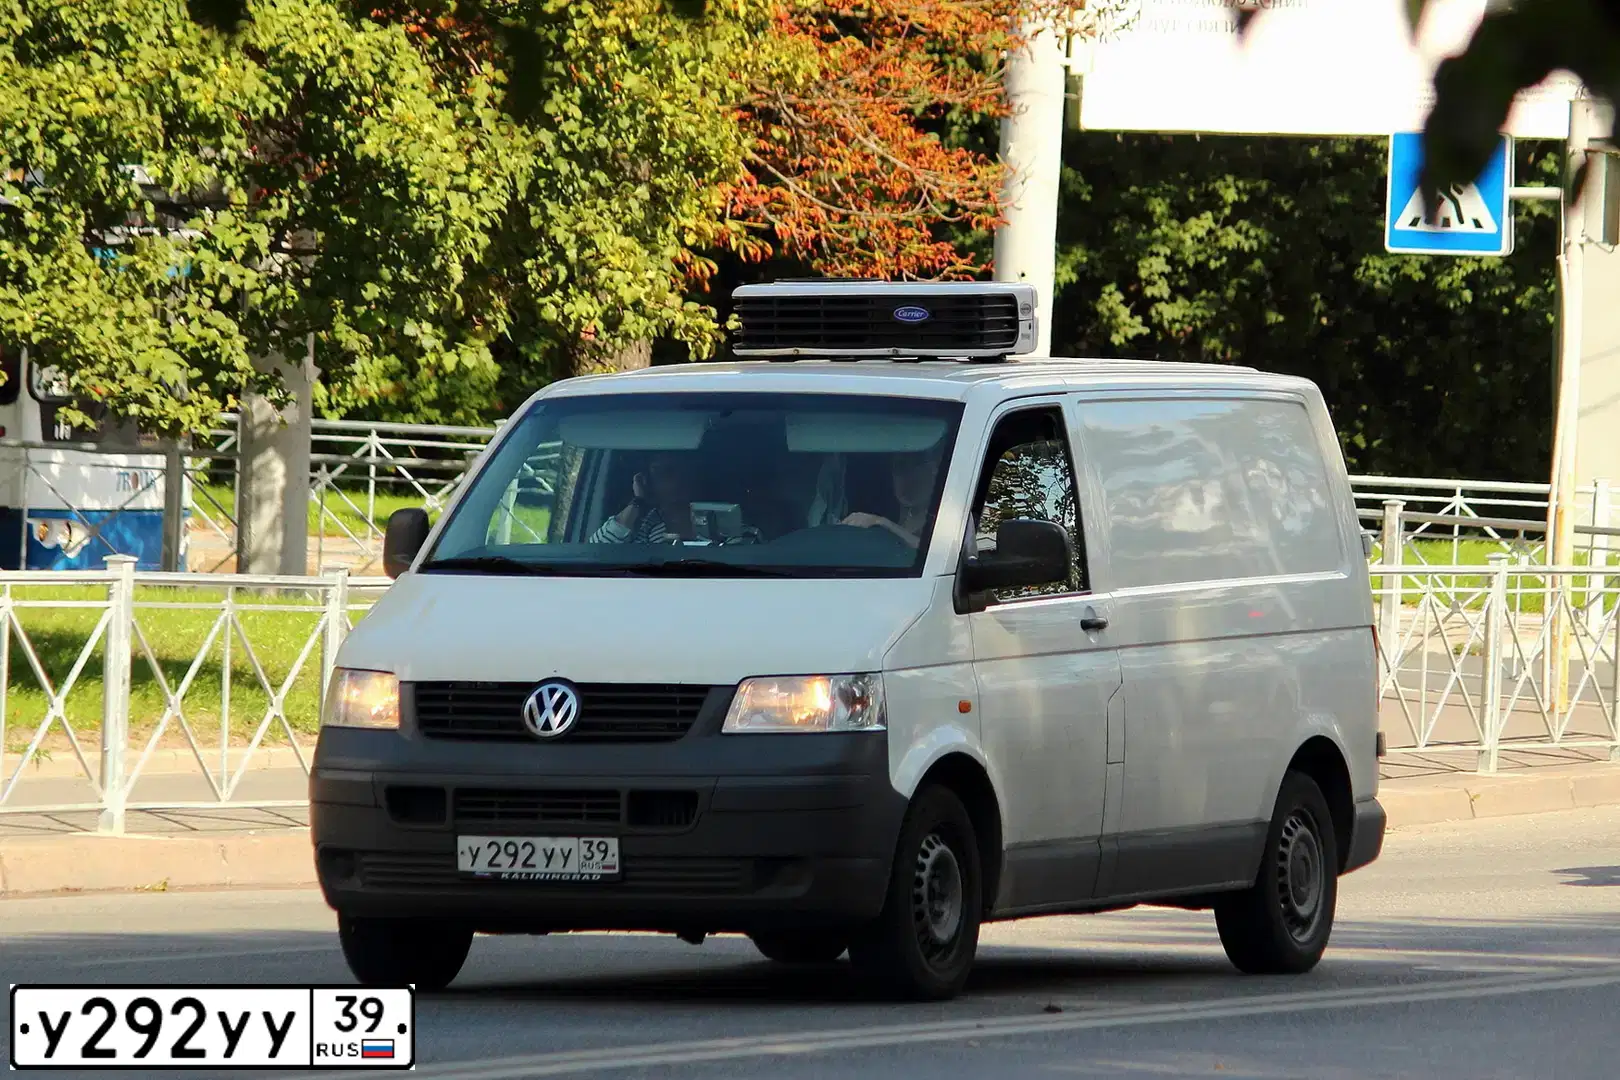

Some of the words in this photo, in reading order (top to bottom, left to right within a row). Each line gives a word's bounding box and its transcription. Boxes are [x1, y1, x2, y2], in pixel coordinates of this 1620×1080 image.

[898, 309, 924, 318] Carrier
[583, 840, 609, 861] 39
[581, 862, 601, 870] RUS
